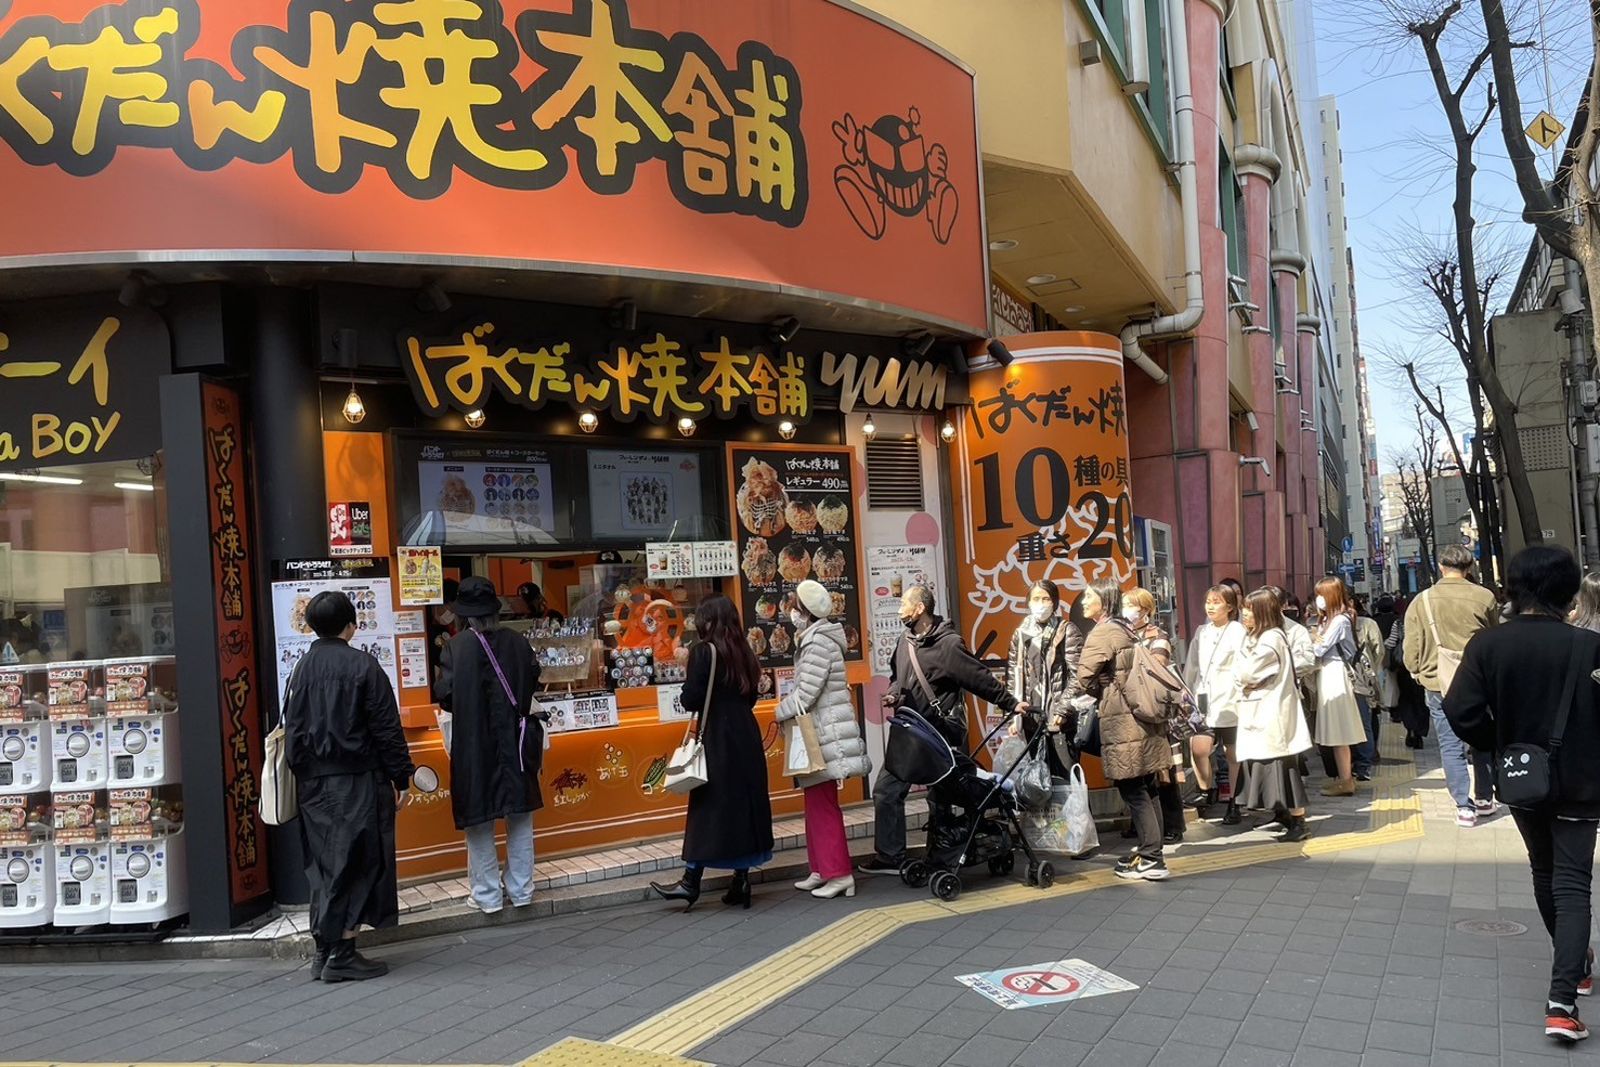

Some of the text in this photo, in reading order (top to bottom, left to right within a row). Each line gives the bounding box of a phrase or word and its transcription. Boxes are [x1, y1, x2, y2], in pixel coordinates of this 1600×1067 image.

[0, 316, 121, 406] ーイ
[407, 322, 808, 418] ばくだん焼本舗
[208, 429, 245, 617] ばくだん焼本舗
[351, 508, 369, 520] Uber
[786, 476, 820, 486] レギュラー
[226, 671, 260, 866] ばくだん焼本舗
[596, 766, 629, 781] あげ玉
